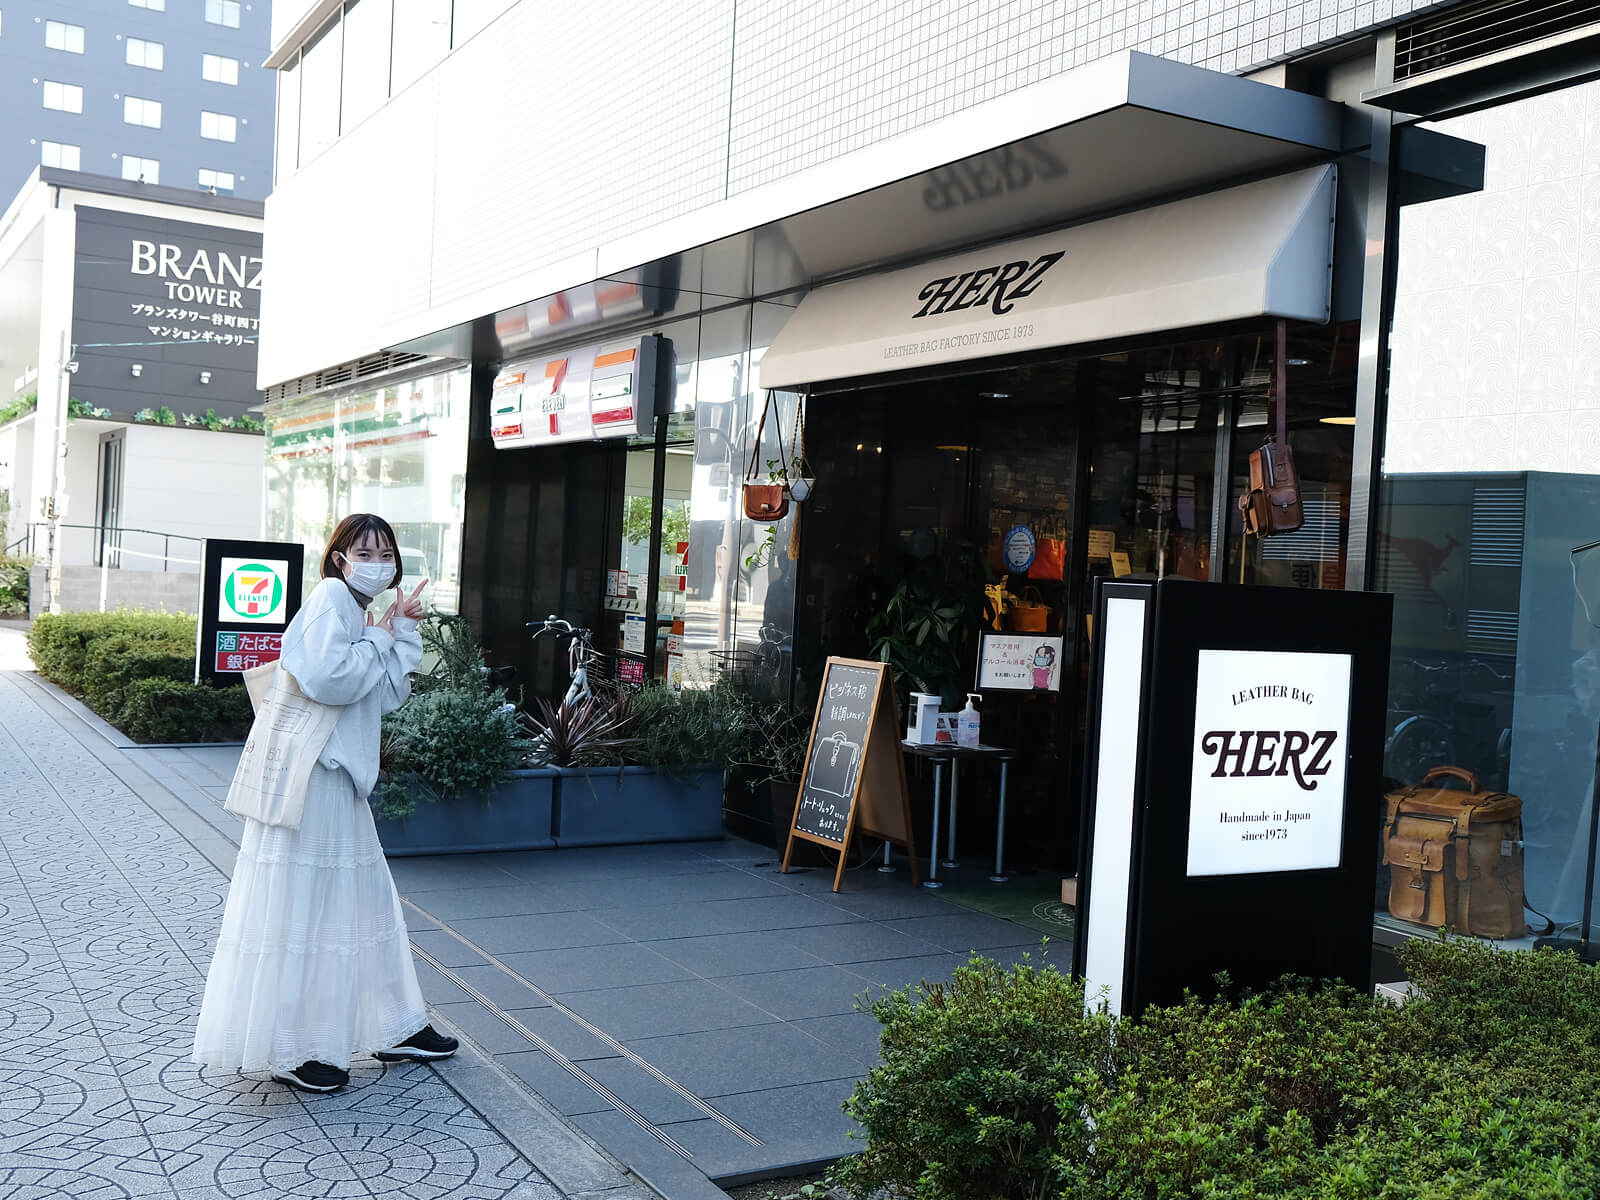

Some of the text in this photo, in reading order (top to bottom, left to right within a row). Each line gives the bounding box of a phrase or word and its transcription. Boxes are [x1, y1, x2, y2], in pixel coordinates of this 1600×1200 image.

[131, 240, 262, 290] BRANZ
[164, 281, 244, 309] TOWER
[911, 250, 1066, 319] HERZ
[148, 325, 255, 346] マンションギャラリー
[884, 324, 1034, 359] LEATHER BAG FACTORY SINCE 1973
[219, 635, 237, 651] 酒
[1231, 685, 1315, 706] LEATHER BAG
[1201, 730, 1338, 791] HERZ
[1219, 810, 1311, 823] Handmade in Japan
[1241, 828, 1288, 841] since1973
